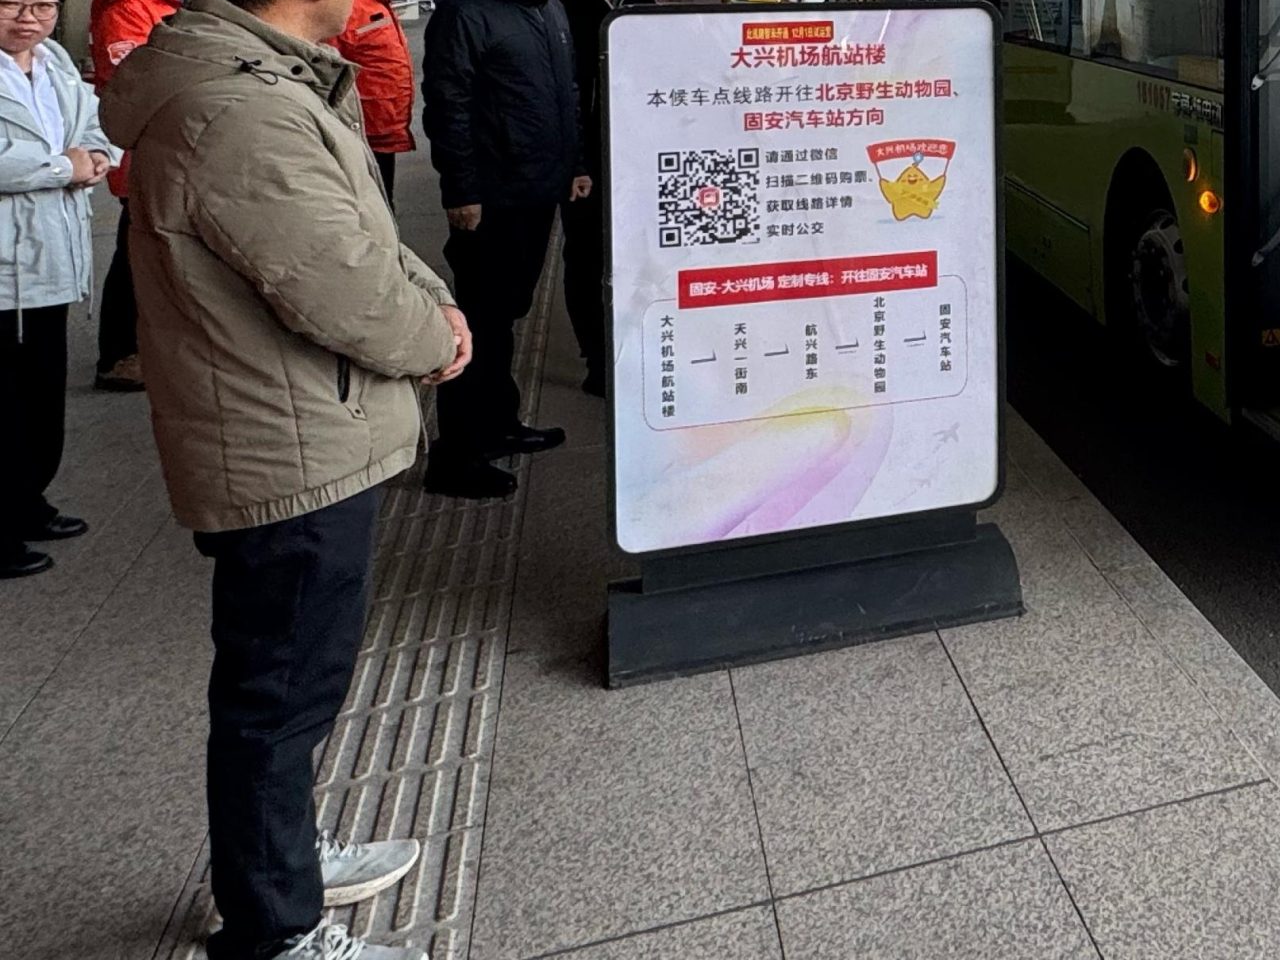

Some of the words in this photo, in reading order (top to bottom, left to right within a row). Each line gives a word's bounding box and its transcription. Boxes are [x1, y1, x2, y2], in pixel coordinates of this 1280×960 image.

[731, 44, 886, 68] 大兴机场航站楼
[744, 107, 884, 131] 固安汽车站方向
[765, 147, 838, 164] 请通过微信
[766, 195, 853, 213] 获取线路详情
[766, 221, 824, 237] 实时公交
[805, 323, 819, 380] 航兴路东
[873, 295, 887, 394] 北京野生动物园
[939, 303, 952, 372] 固安汽车站
[660, 315, 676, 418] 大兴机场航站楼
[734, 322, 748, 395] 天兴一街南
